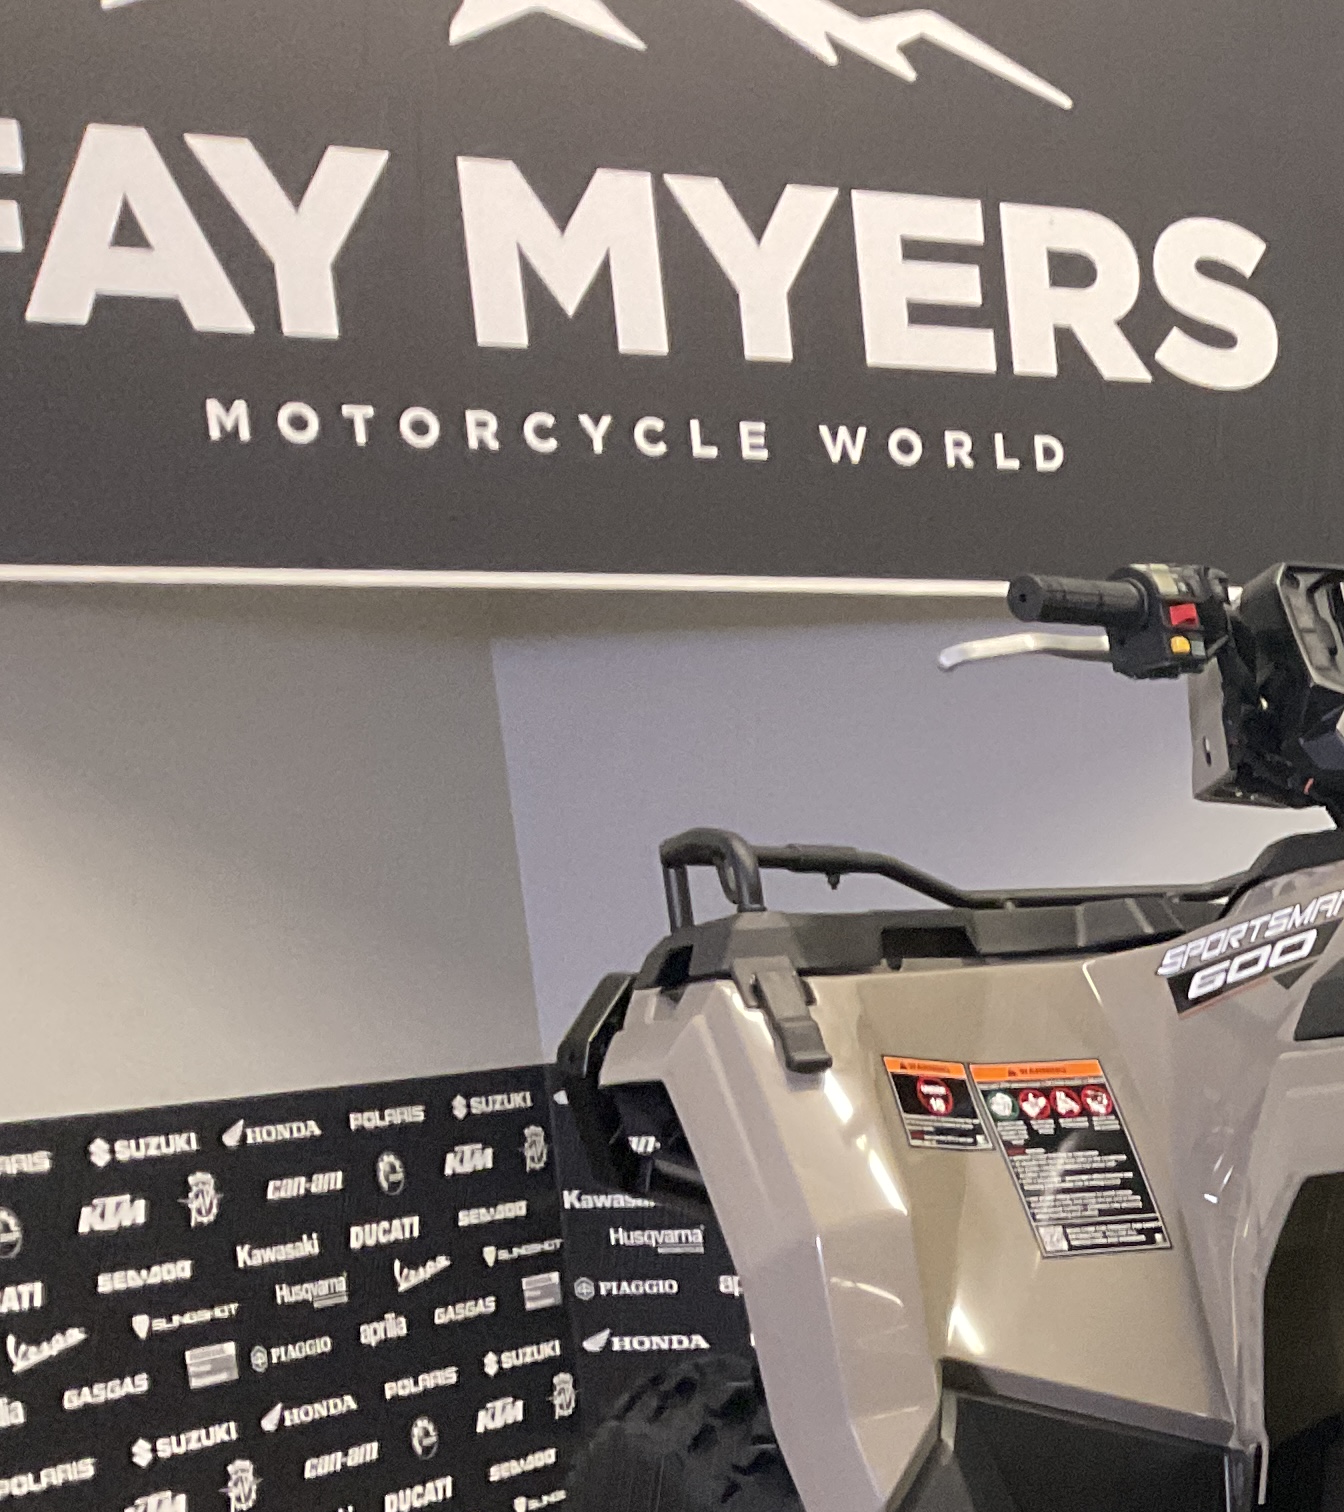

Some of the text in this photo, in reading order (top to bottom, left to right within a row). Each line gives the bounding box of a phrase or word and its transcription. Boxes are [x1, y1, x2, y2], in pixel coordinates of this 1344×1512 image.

[456, 155, 1279, 391] MYERS
[205, 398, 1064, 472] MOTORCYCLE WORLD
[1187, 928, 1318, 1001] 600
[349, 1105, 425, 1132] POLARIS
[469, 1091, 532, 1115] SUZUKI
[113, 1131, 200, 1162] SUZUKI
[245, 1119, 322, 1144] HONDA
[443, 1143, 494, 1177] KTM
[266, 1170, 343, 1201] can-am
[77, 1193, 146, 1234] KTM
[349, 1215, 420, 1250] DUCATI
[609, 1226, 705, 1247] Husqvarna
[235, 1232, 320, 1268] Kawasaki
[275, 1272, 349, 1308] Husqvarna
[598, 1279, 679, 1296] PIAGGIO
[433, 1295, 496, 1325] GASGAS
[359, 1312, 408, 1348] aprilia
[611, 1334, 710, 1352] HONDA
[270, 1336, 332, 1364] PIAGGIO
[500, 1339, 561, 1369] SUZUKI
[63, 1372, 149, 1410] GASGAS
[384, 1366, 459, 1401] POLARIS
[283, 1394, 358, 1427] HONDA
[475, 1396, 524, 1434] KTM
[155, 1421, 239, 1459] SUZUKI
[303, 1441, 379, 1480] can-am
